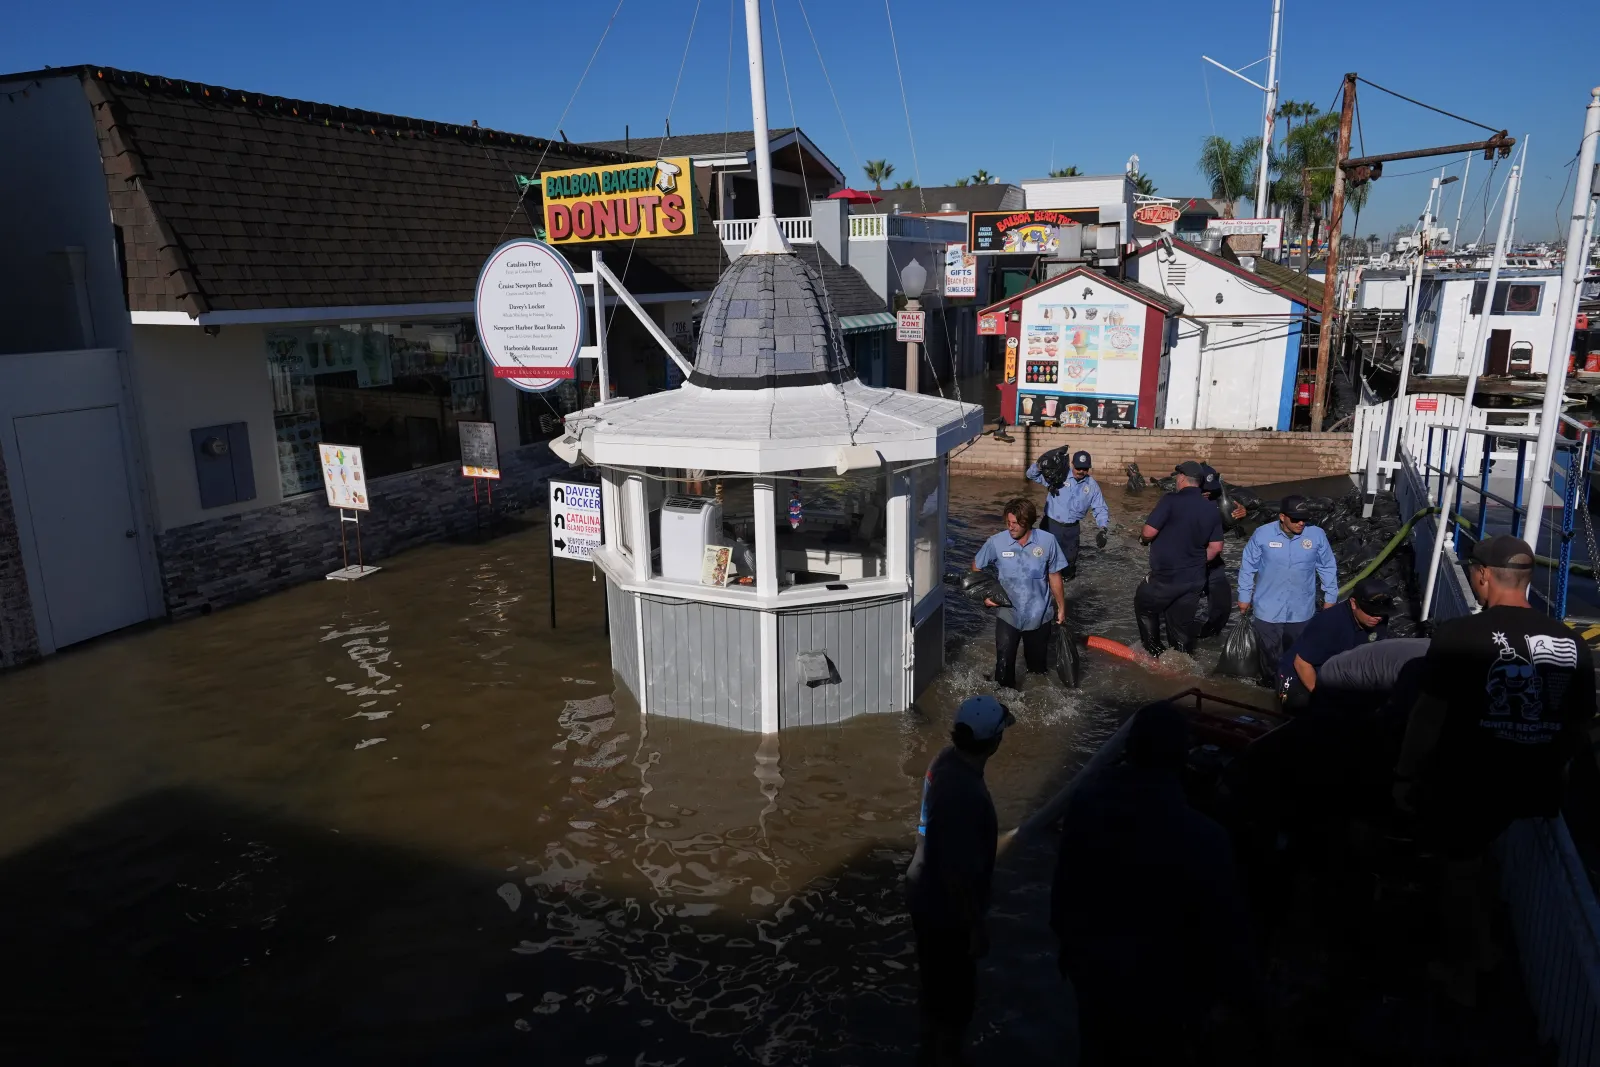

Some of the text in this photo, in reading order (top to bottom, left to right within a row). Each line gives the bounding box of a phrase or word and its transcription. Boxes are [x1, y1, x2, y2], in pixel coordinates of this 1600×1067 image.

[546, 166, 656, 199] BALBOA BAKERY
[547, 193, 685, 240] DONUTS
[996, 211, 1031, 233] BALBOA
[1033, 210, 1058, 222] BEACH
[1222, 224, 1277, 234] ARBOR
[528, 260, 541, 268] Flyer
[509, 303, 527, 311] Davey's
[1006, 350, 1015, 370] ATM
[565, 485, 600, 499] DAVEYS
[566, 496, 600, 509] LOCKER
[566, 512, 600, 526] CATALINA
[567, 523, 601, 534] ISLAND FERRY
[567, 536, 585, 545] NEWPORT
[567, 544, 580, 554] BOAT
[1479, 718, 1514, 730] IGNITE
